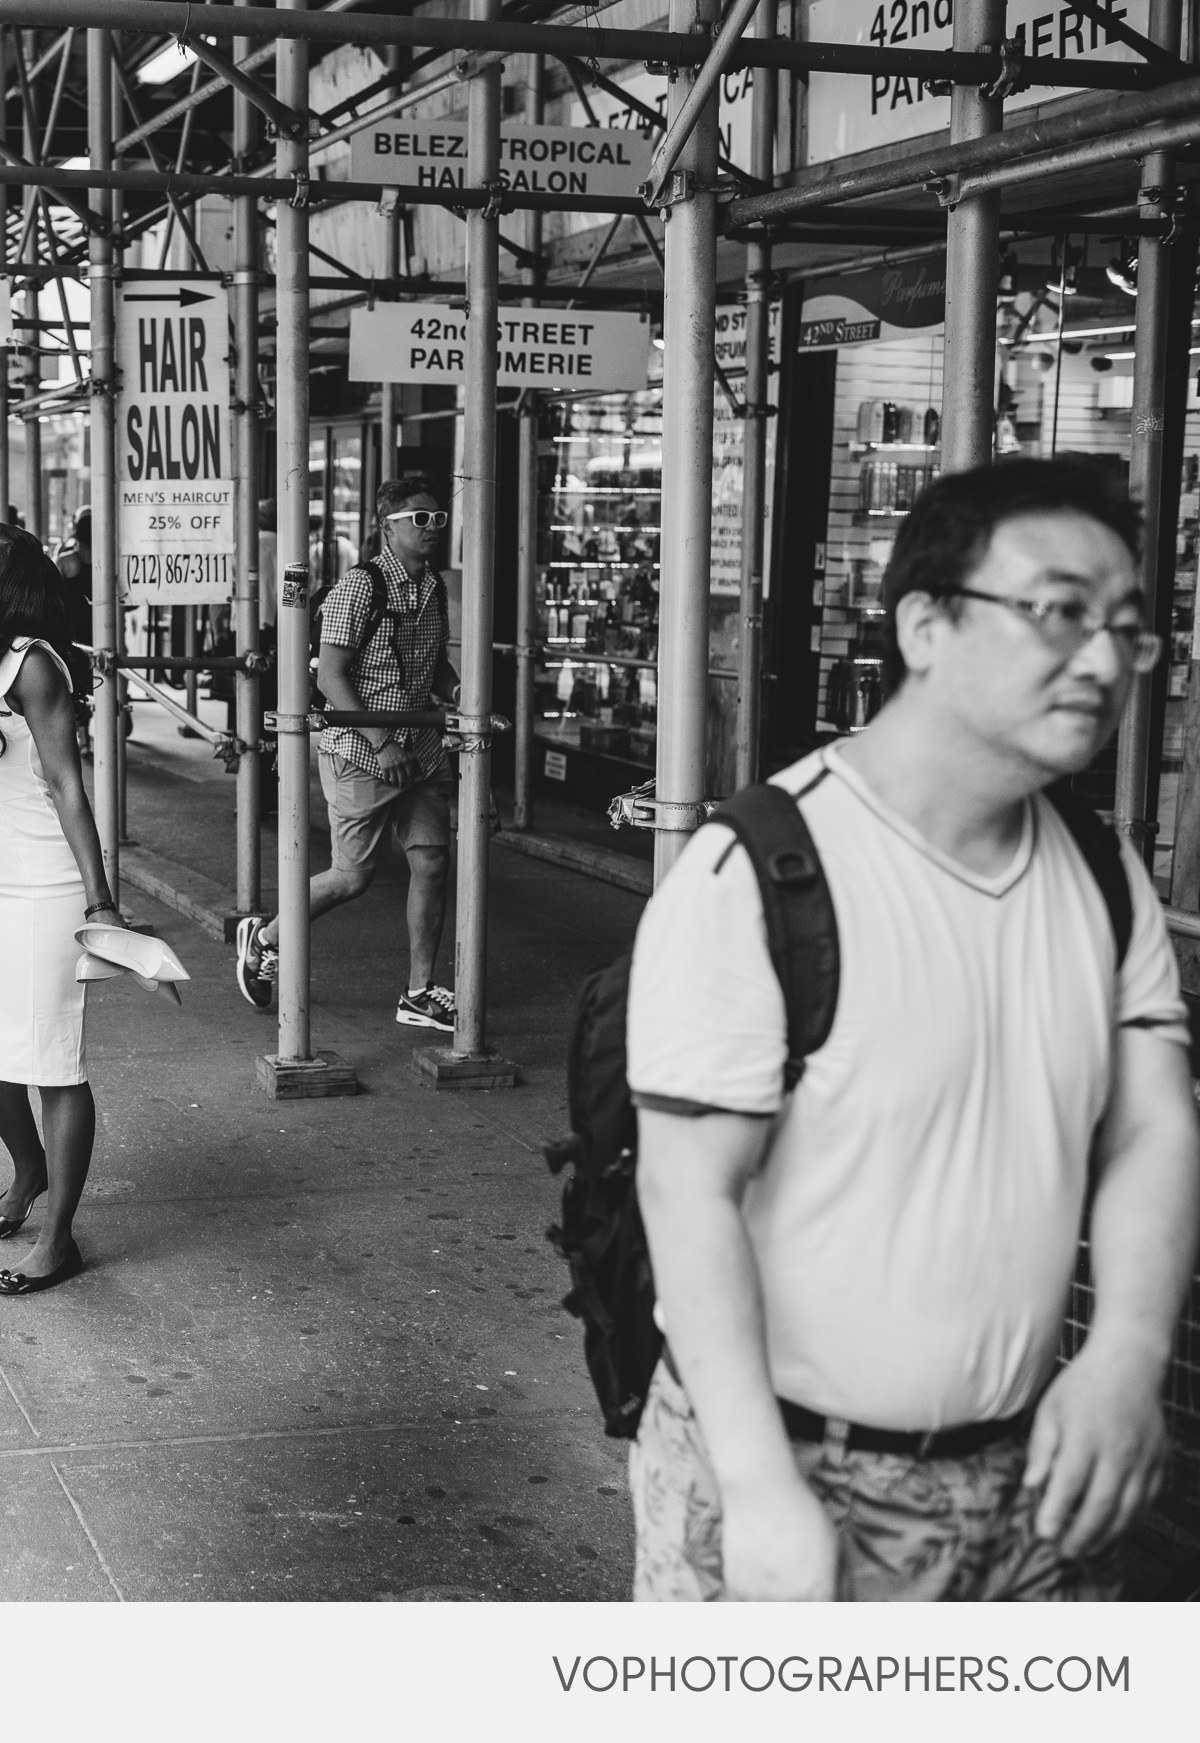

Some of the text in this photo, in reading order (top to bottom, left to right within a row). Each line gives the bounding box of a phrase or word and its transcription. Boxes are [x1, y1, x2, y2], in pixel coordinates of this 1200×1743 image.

[374, 132, 468, 159] BELEZ
[418, 165, 587, 194] HAI SALON
[498, 321, 594, 345] TREET
[138, 317, 209, 394] HAIR
[127, 403, 221, 481] SALON
[123, 491, 230, 504] MEN'S HAIRCUT
[148, 515, 221, 529] 25% OFF
[126, 553, 228, 592] (212) 867-3111
